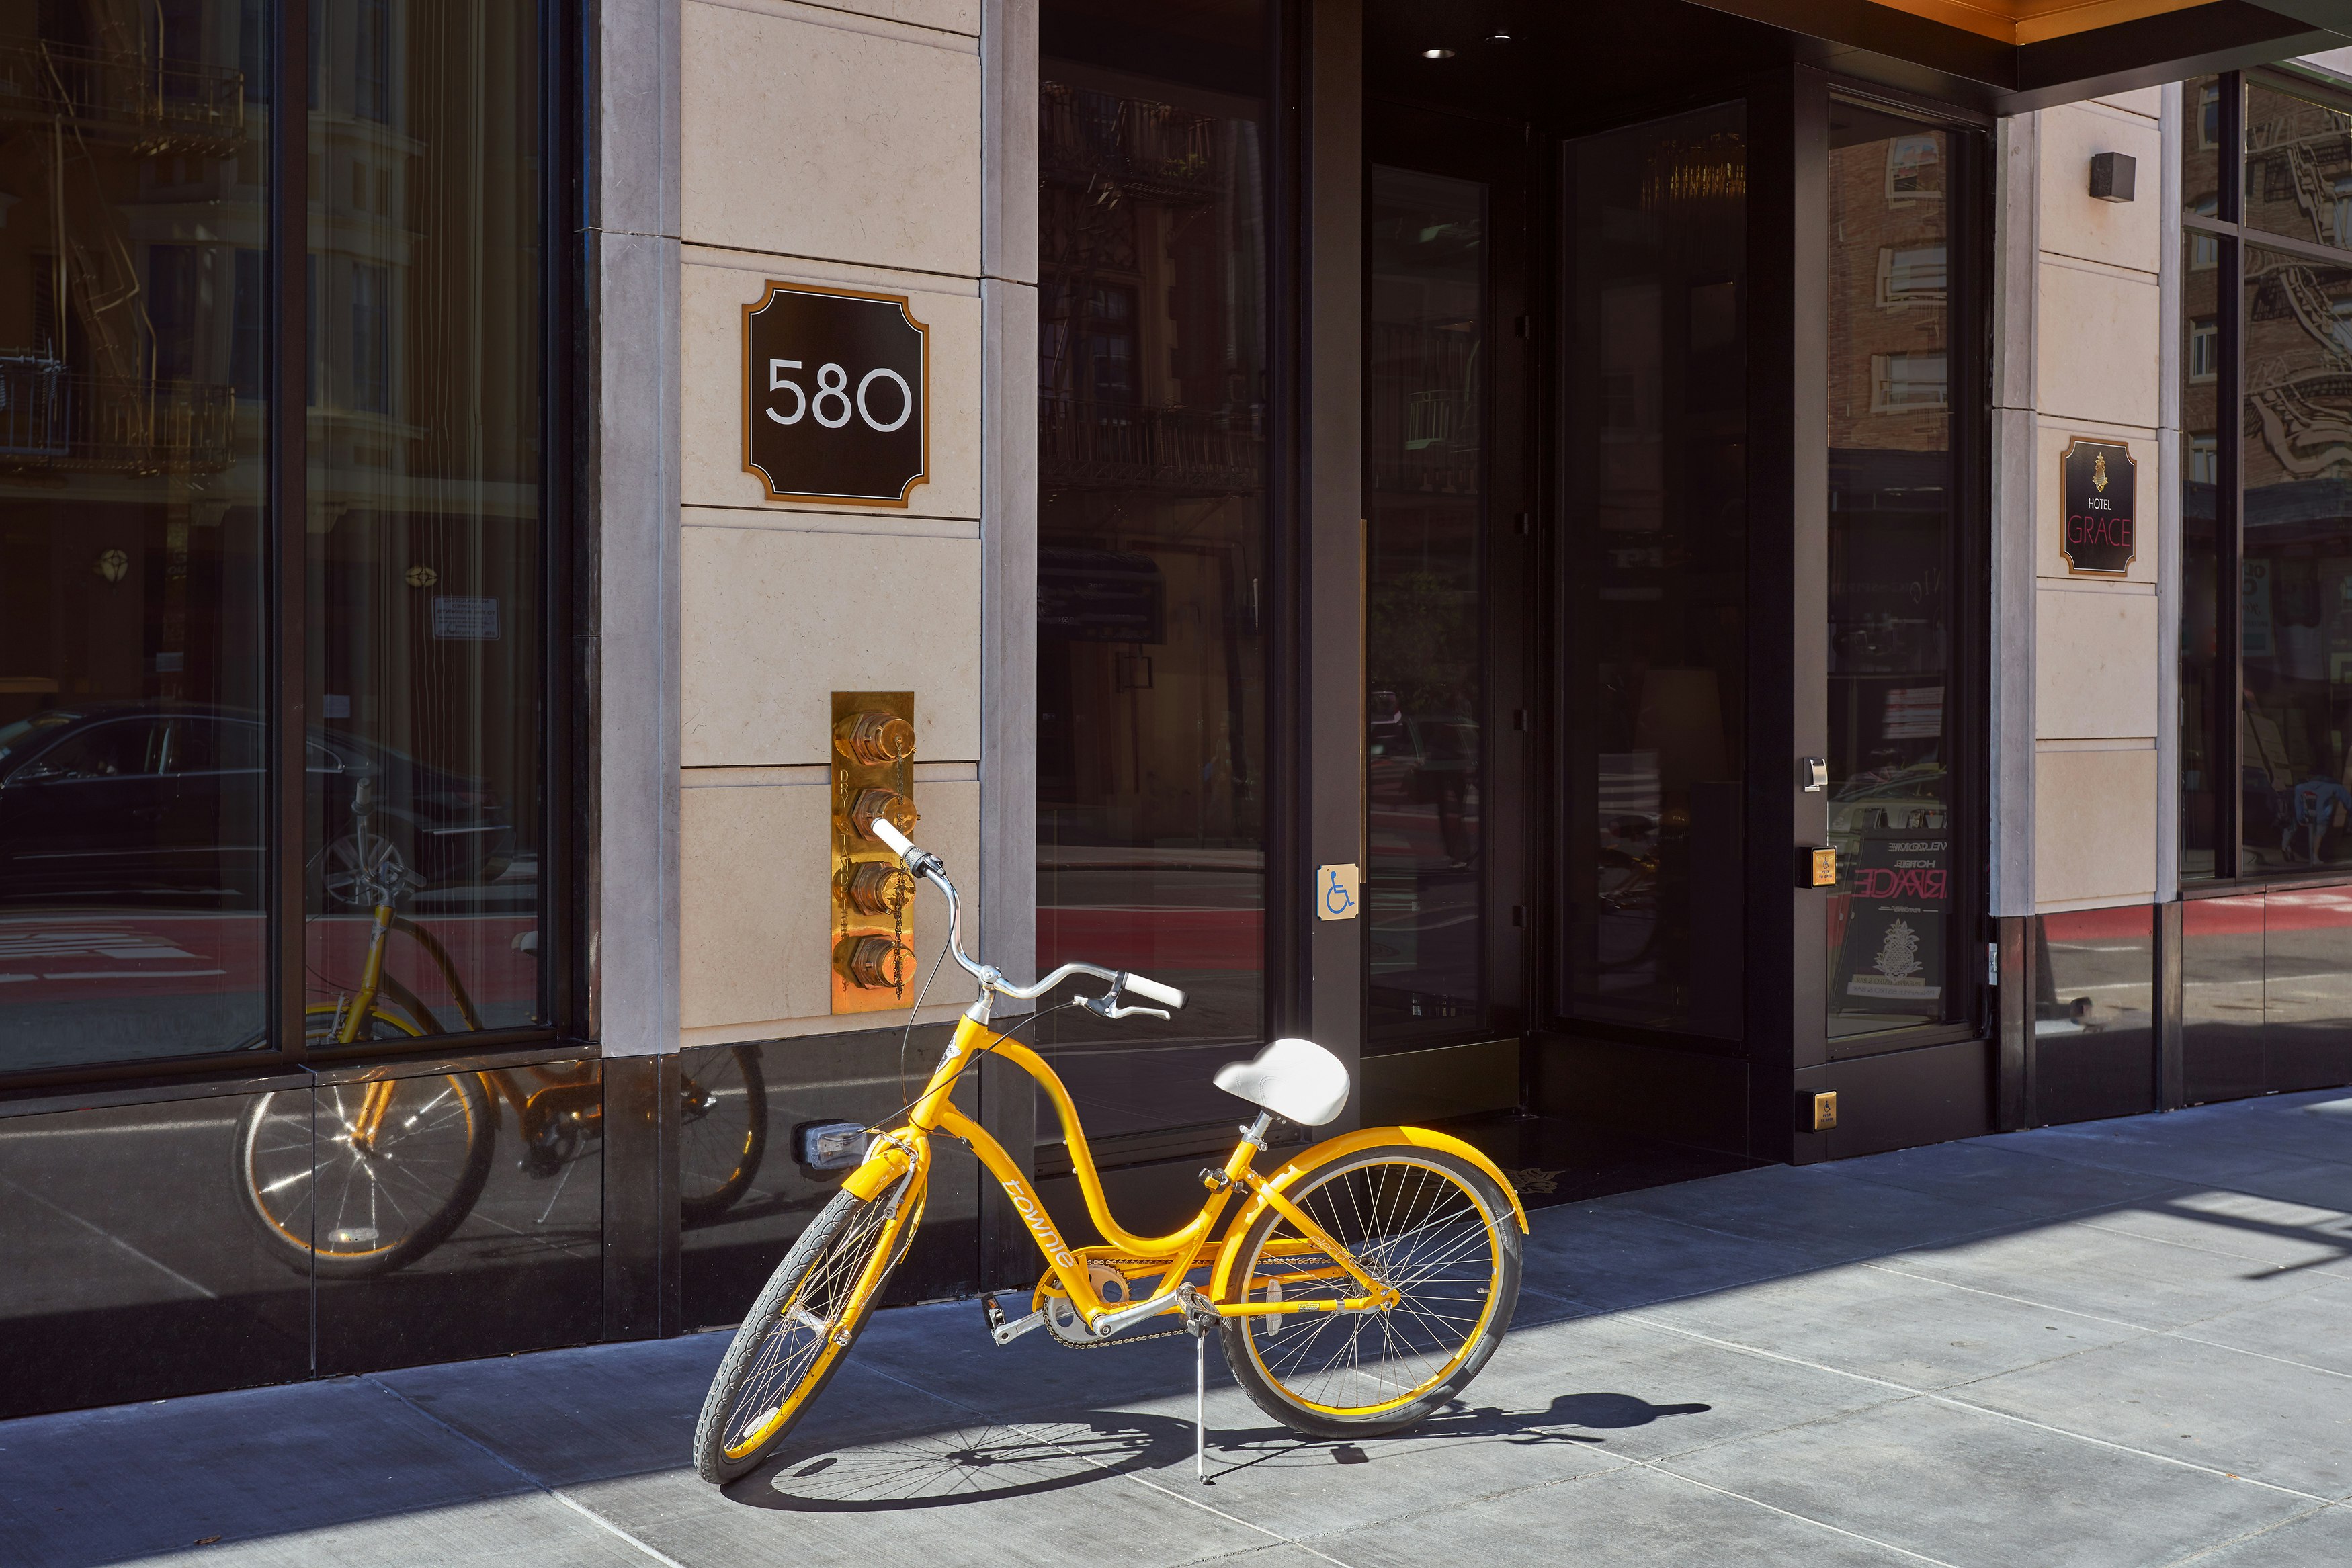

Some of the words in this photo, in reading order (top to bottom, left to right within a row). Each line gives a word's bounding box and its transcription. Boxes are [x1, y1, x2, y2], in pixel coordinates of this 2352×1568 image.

[766, 358, 912, 432] 580
[2088, 498, 2112, 511] HOTEL
[2068, 515, 2131, 547] GRACE
[840, 769, 849, 808] DRY
[1002, 1179, 1074, 1268] townie
[1310, 1236, 1357, 1270] electra
